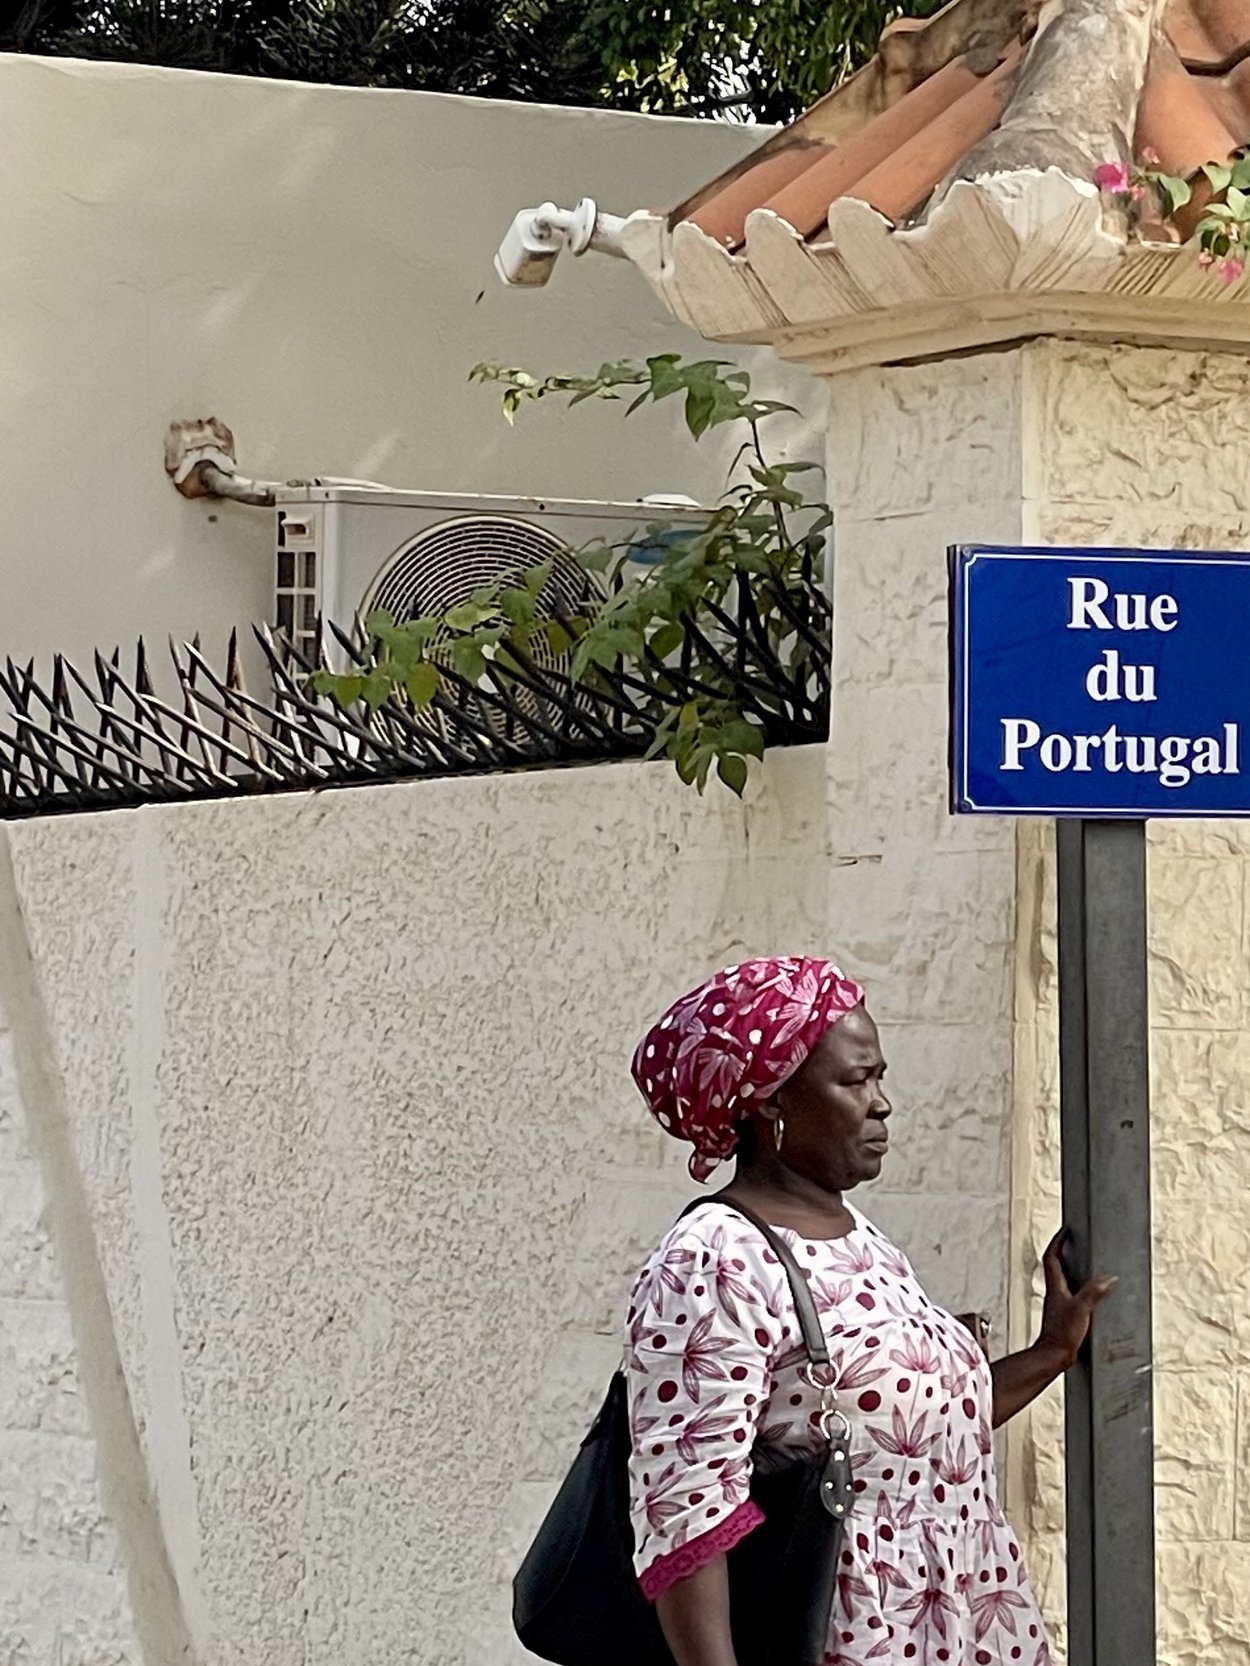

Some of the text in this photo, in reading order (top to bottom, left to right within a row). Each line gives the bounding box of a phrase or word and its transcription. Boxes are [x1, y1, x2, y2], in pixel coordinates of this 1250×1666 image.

[1066, 577, 1178, 632] Rue
[1086, 649, 1158, 702] du
[999, 718, 1240, 788] Portugal
